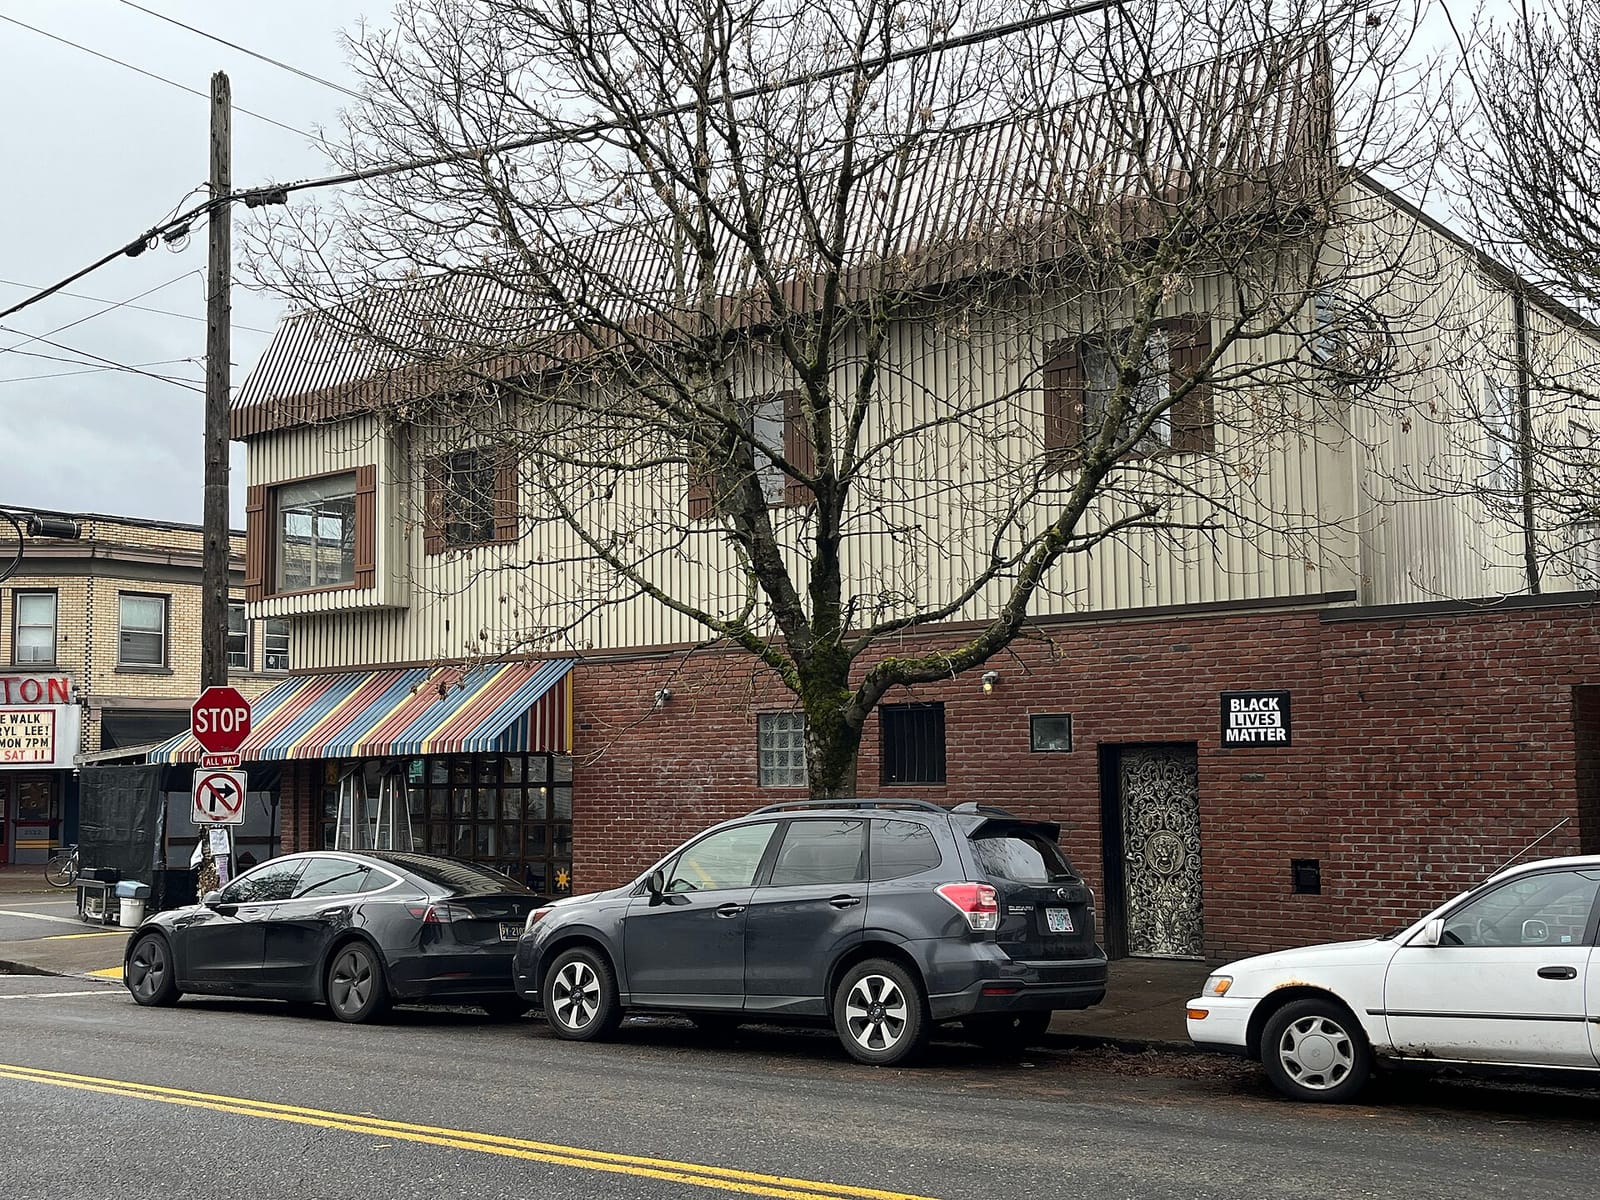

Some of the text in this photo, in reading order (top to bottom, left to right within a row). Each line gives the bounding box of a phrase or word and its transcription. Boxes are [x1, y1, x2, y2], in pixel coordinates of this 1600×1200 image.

[1230, 697, 1280, 712] BLACK
[10, 713, 41, 724] WALK
[195, 707, 248, 733] STOP
[1234, 712, 1276, 727] LIVES
[25, 725, 49, 736] LEE!
[1226, 728, 1287, 742] MATTER
[25, 737, 49, 748] 7PM
[4, 750, 25, 760] SAT
[205, 756, 237, 766] ALL WAY
